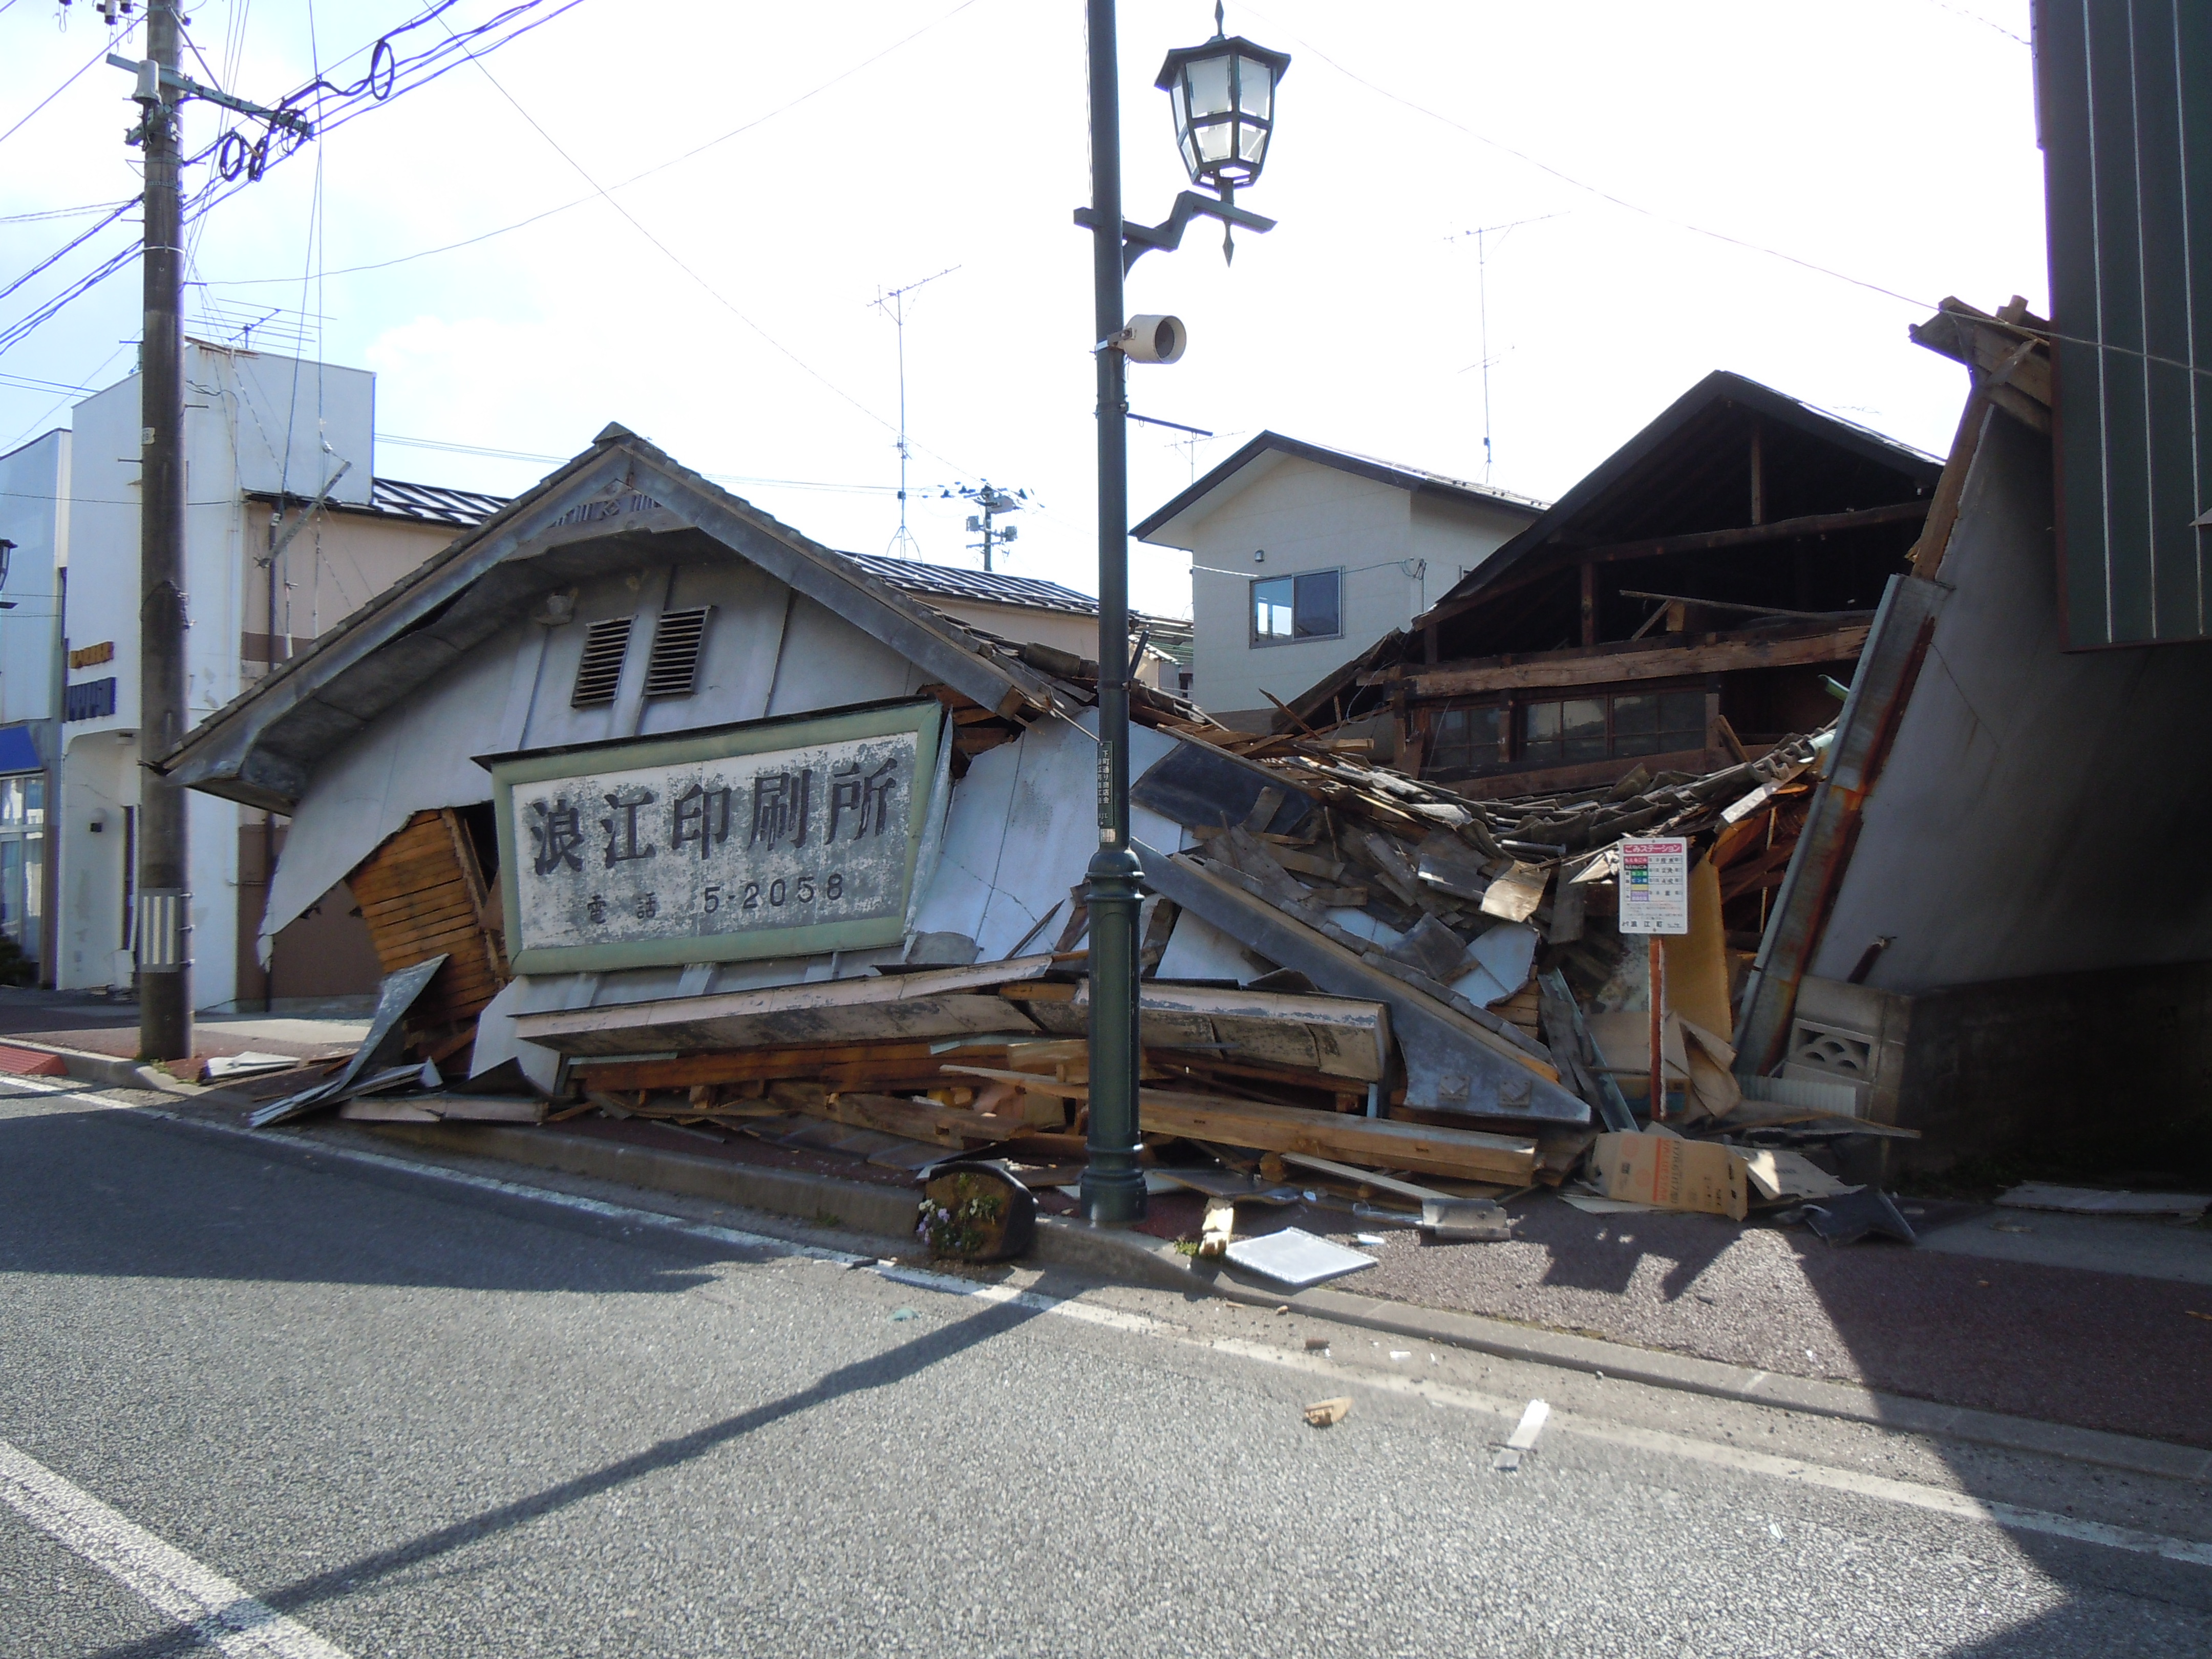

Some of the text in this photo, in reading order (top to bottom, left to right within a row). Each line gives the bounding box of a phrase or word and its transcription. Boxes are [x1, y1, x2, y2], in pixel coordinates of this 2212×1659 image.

[1102, 750, 1110, 804] 下町通り商店会
[531, 757, 898, 876] 浪江印刷所
[705, 874, 844, 914] 5-2058
